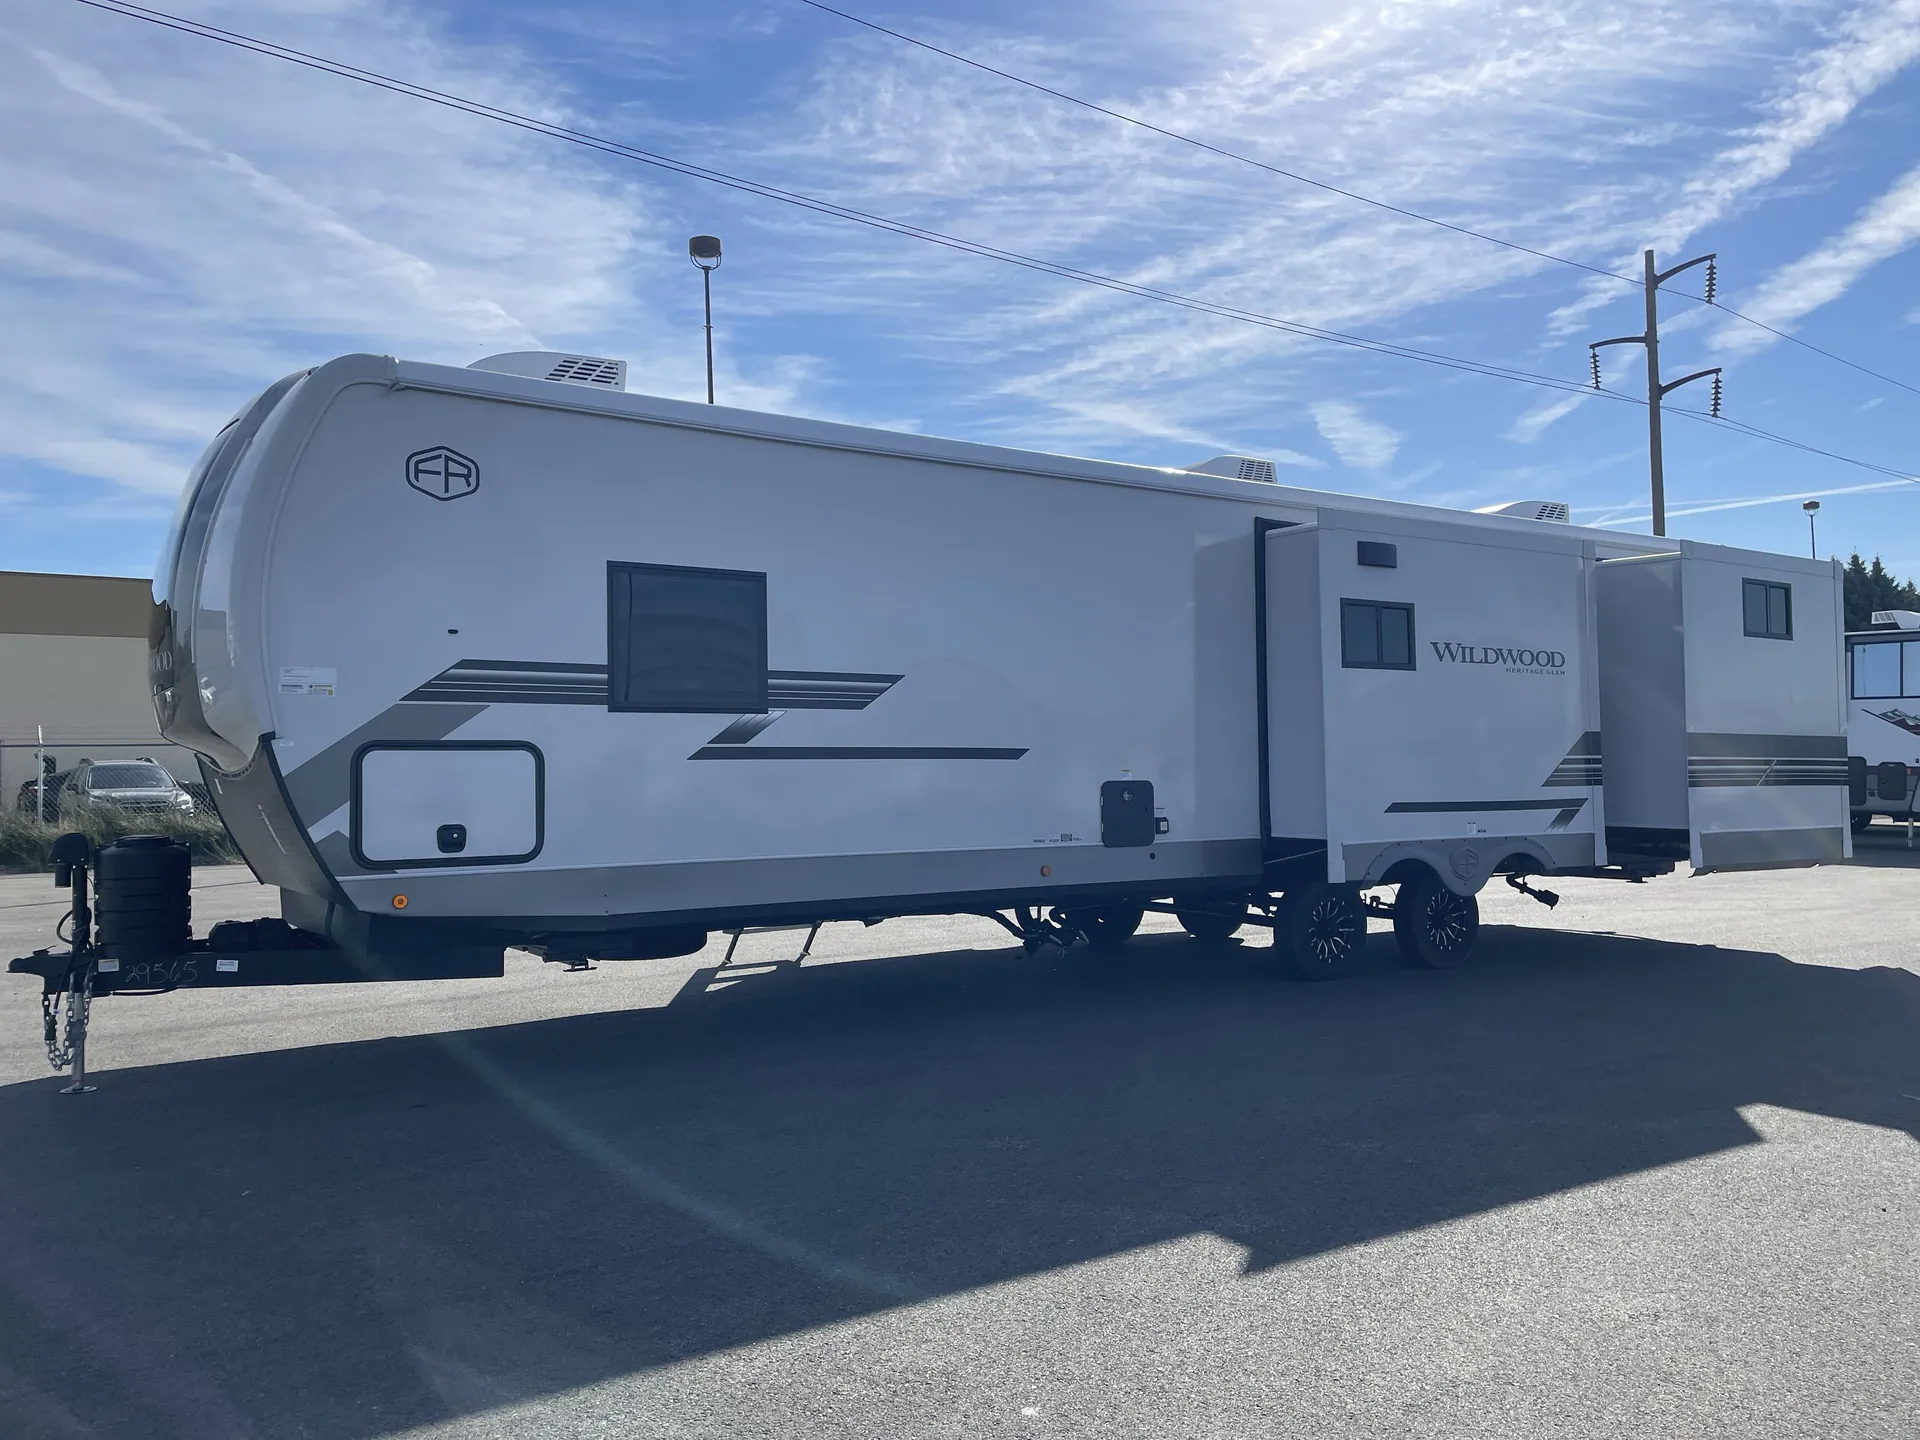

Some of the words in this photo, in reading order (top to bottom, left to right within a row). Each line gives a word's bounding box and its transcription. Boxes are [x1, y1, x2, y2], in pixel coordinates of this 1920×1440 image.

[413, 453, 472, 494] FR
[1429, 640, 1566, 668] WILDWOOD
[1505, 667, 1544, 675] HERITAGE
[124, 960, 198, 985] 29565
